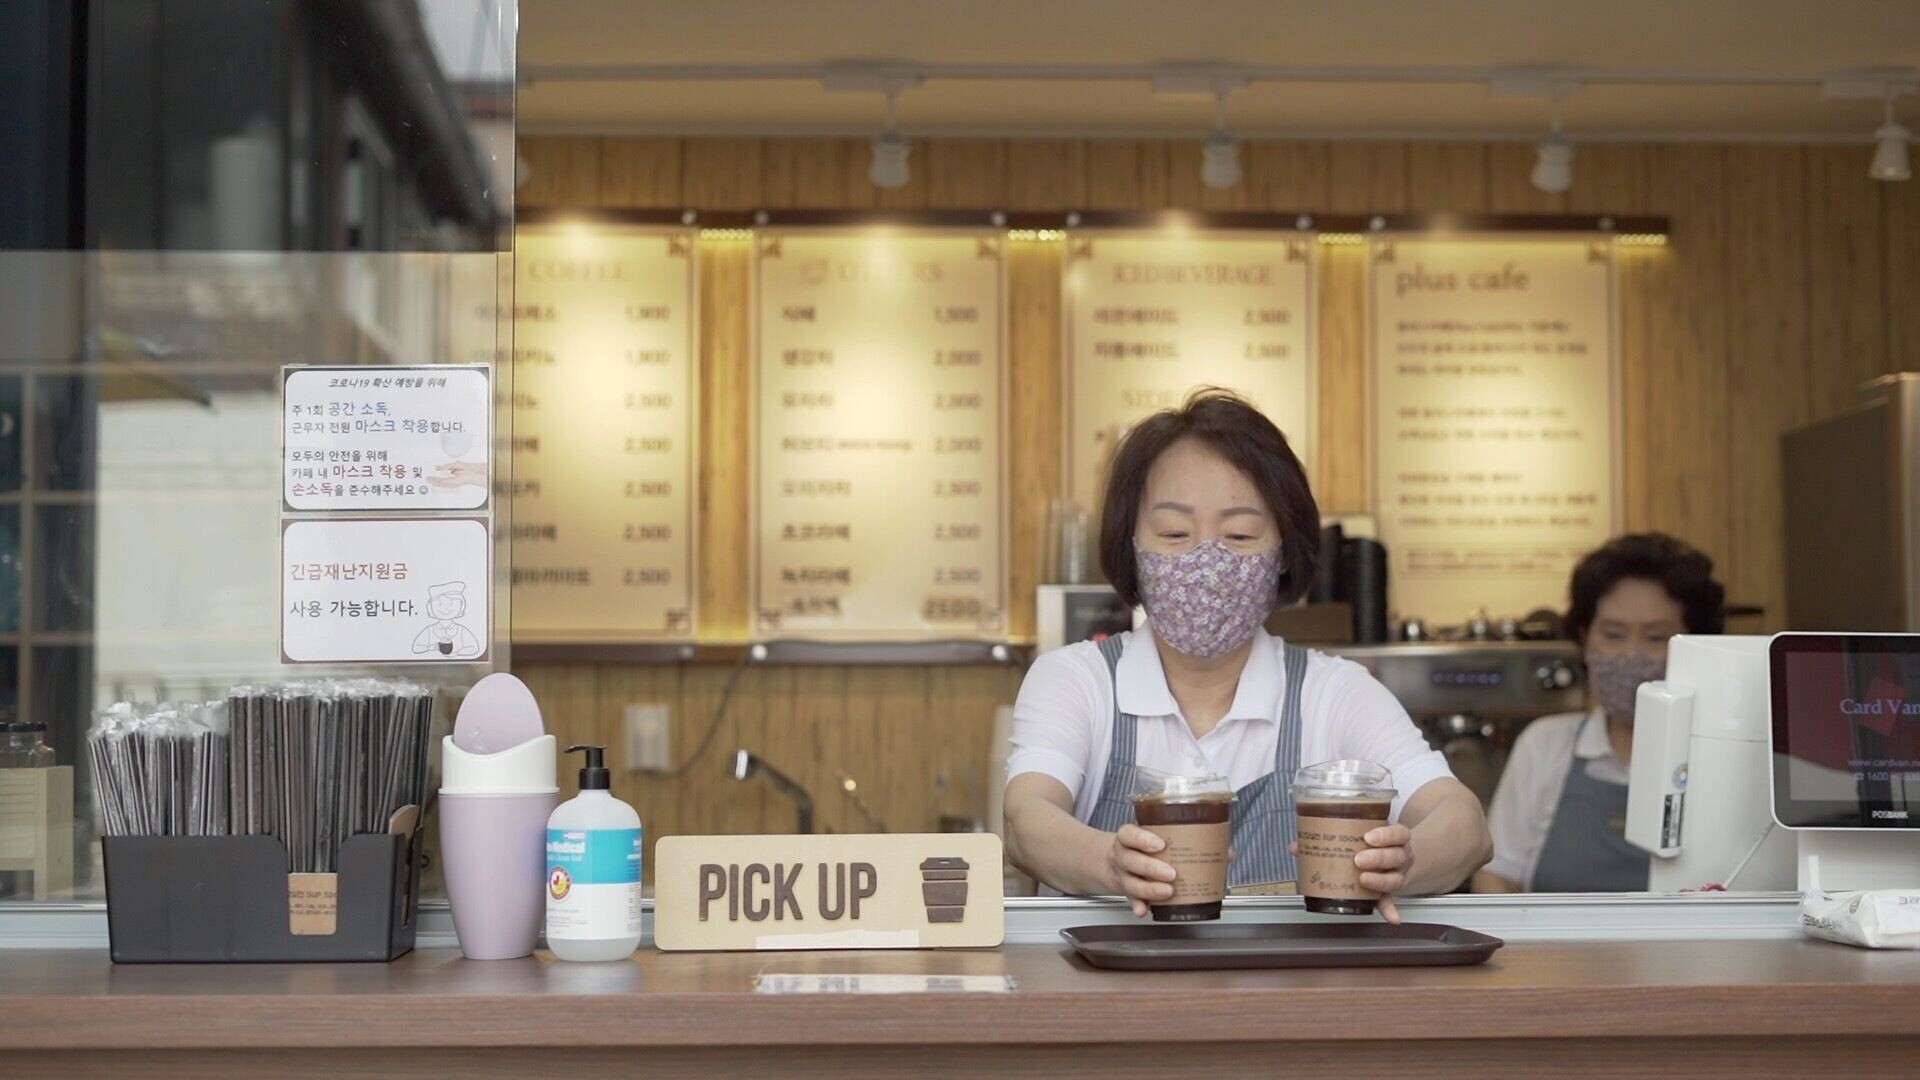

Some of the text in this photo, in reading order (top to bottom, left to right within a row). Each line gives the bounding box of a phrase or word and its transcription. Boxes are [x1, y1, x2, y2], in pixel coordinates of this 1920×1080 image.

[1396, 262, 1531, 297] plus cafe
[328, 377, 447, 389] 코로나19 확산 예방을 위해
[292, 401, 391, 416] 주 1회 공간 소독,
[292, 419, 466, 434] 근무자 전원 마스크 착용합니다.
[292, 450, 388, 462] 모두의 안전을 위해
[292, 464, 423, 479] 카페 내 마스크 착용 및
[291, 482, 416, 497] 손소독을 준수해주세요
[290, 562, 408, 581] 긴급재난지원금
[289, 600, 419, 618] 사용 가능합니다.
[1840, 699, 1883, 715] Card
[1872, 810, 1909, 819] POSBANK
[698, 862, 803, 921] PICK
[818, 862, 878, 920] UP
